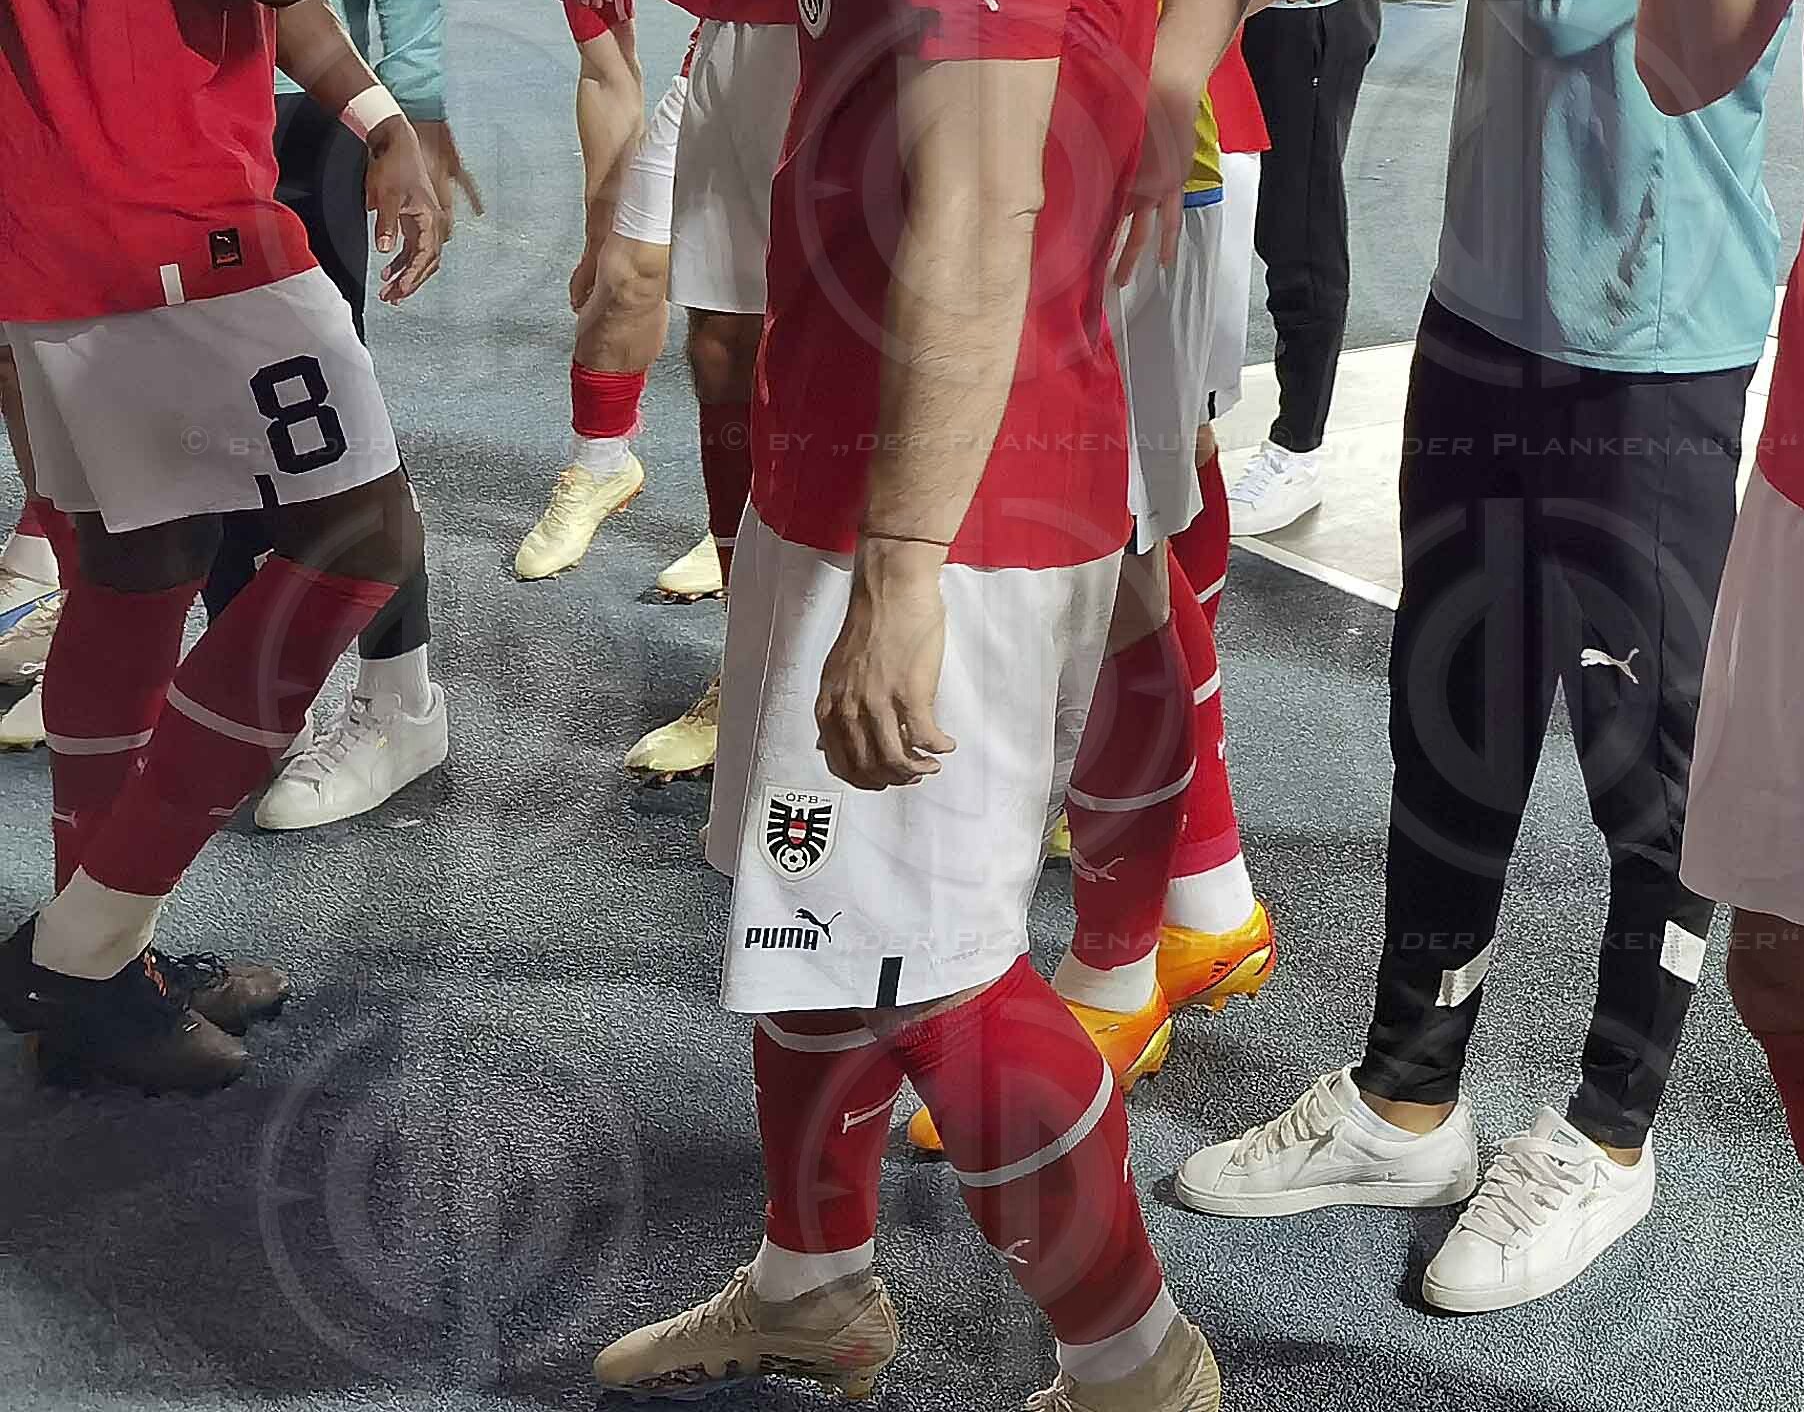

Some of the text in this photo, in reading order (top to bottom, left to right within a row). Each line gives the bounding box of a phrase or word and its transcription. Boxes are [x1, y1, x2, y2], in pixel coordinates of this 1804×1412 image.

[249, 354, 348, 475] 8
[785, 792, 819, 805] ÖFB
[744, 927, 819, 951] PUMA
